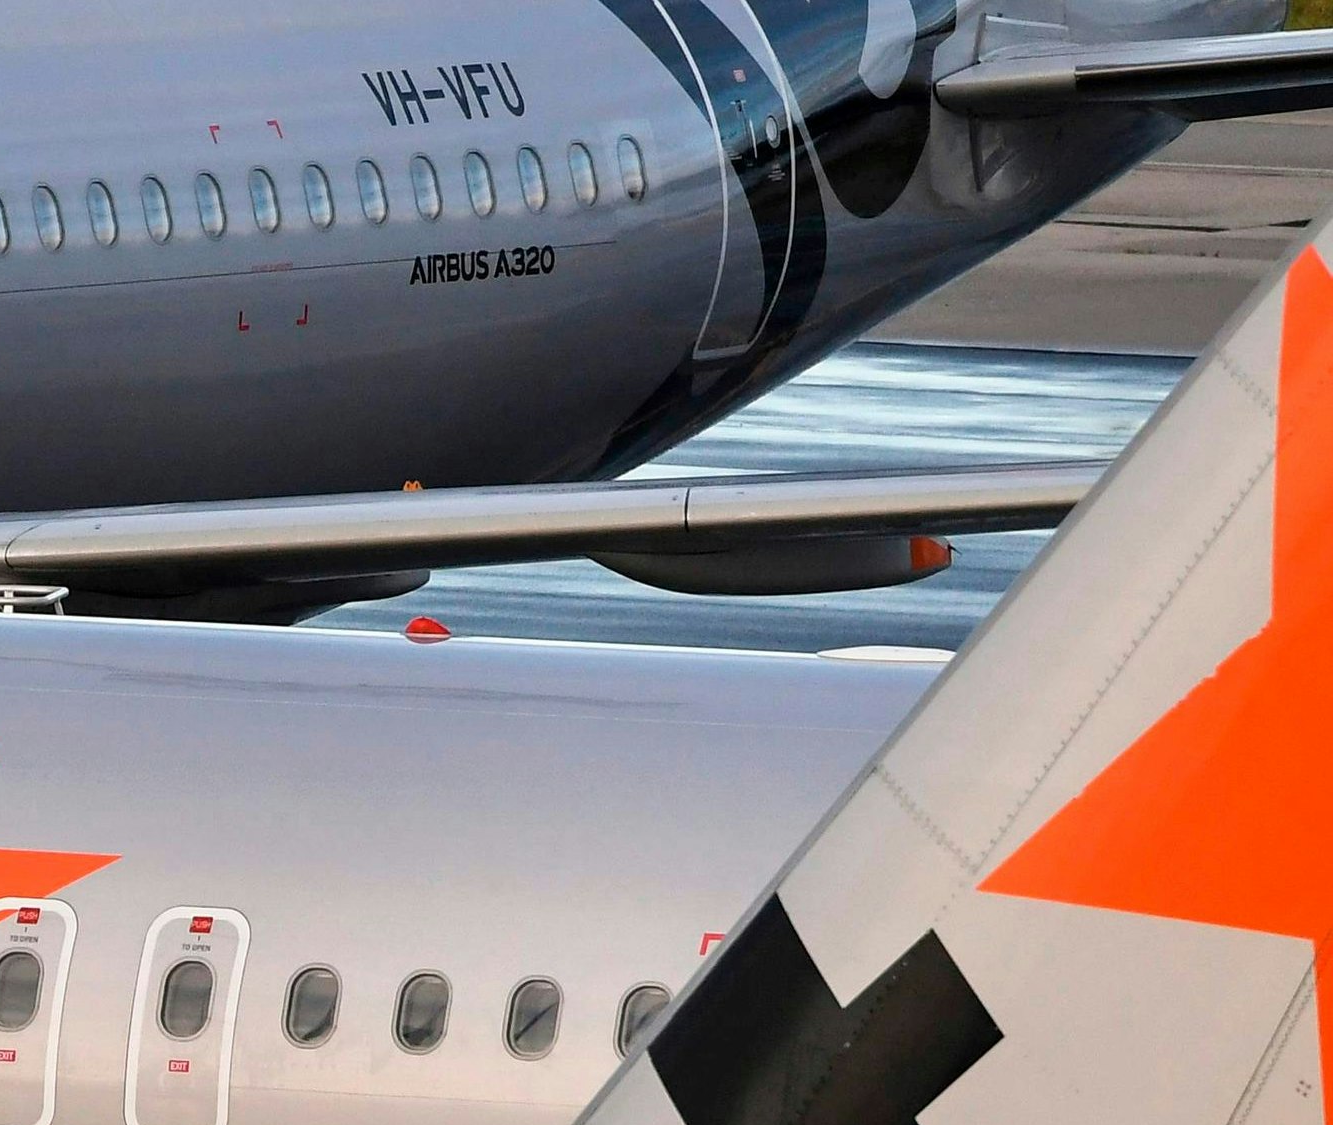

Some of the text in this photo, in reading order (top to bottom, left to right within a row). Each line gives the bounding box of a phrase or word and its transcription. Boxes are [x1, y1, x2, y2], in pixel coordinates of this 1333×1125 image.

[361, 61, 526, 127] VH-VFU
[409, 245, 556, 285] AIRBUS A320
[170, 1061, 189, 1071] EXIT
